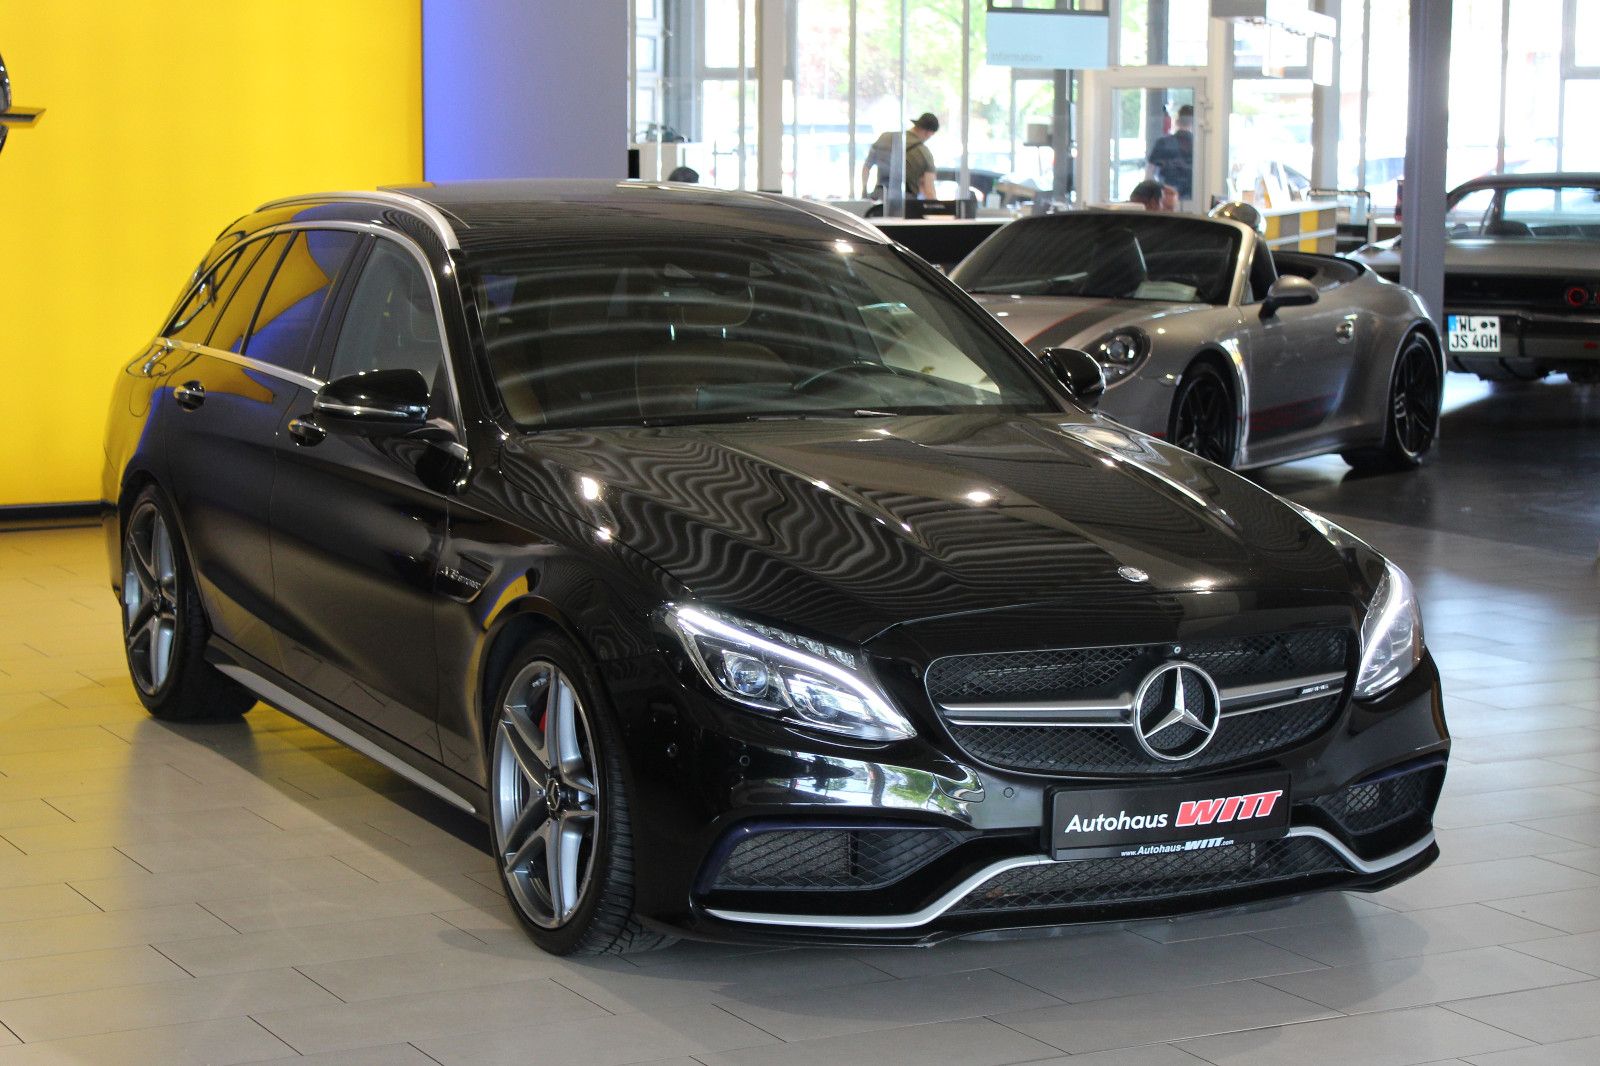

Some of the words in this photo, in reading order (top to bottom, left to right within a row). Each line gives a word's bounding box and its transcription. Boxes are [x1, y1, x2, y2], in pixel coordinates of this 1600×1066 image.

[1459, 316, 1477, 332] WL
[1451, 334, 1468, 349] JS
[1472, 334, 1498, 349] 40H
[1064, 811, 1168, 833] Autohaus
[1175, 790, 1283, 827] WITT
[1121, 837, 1234, 857] www.Autohaus-WITT.com
